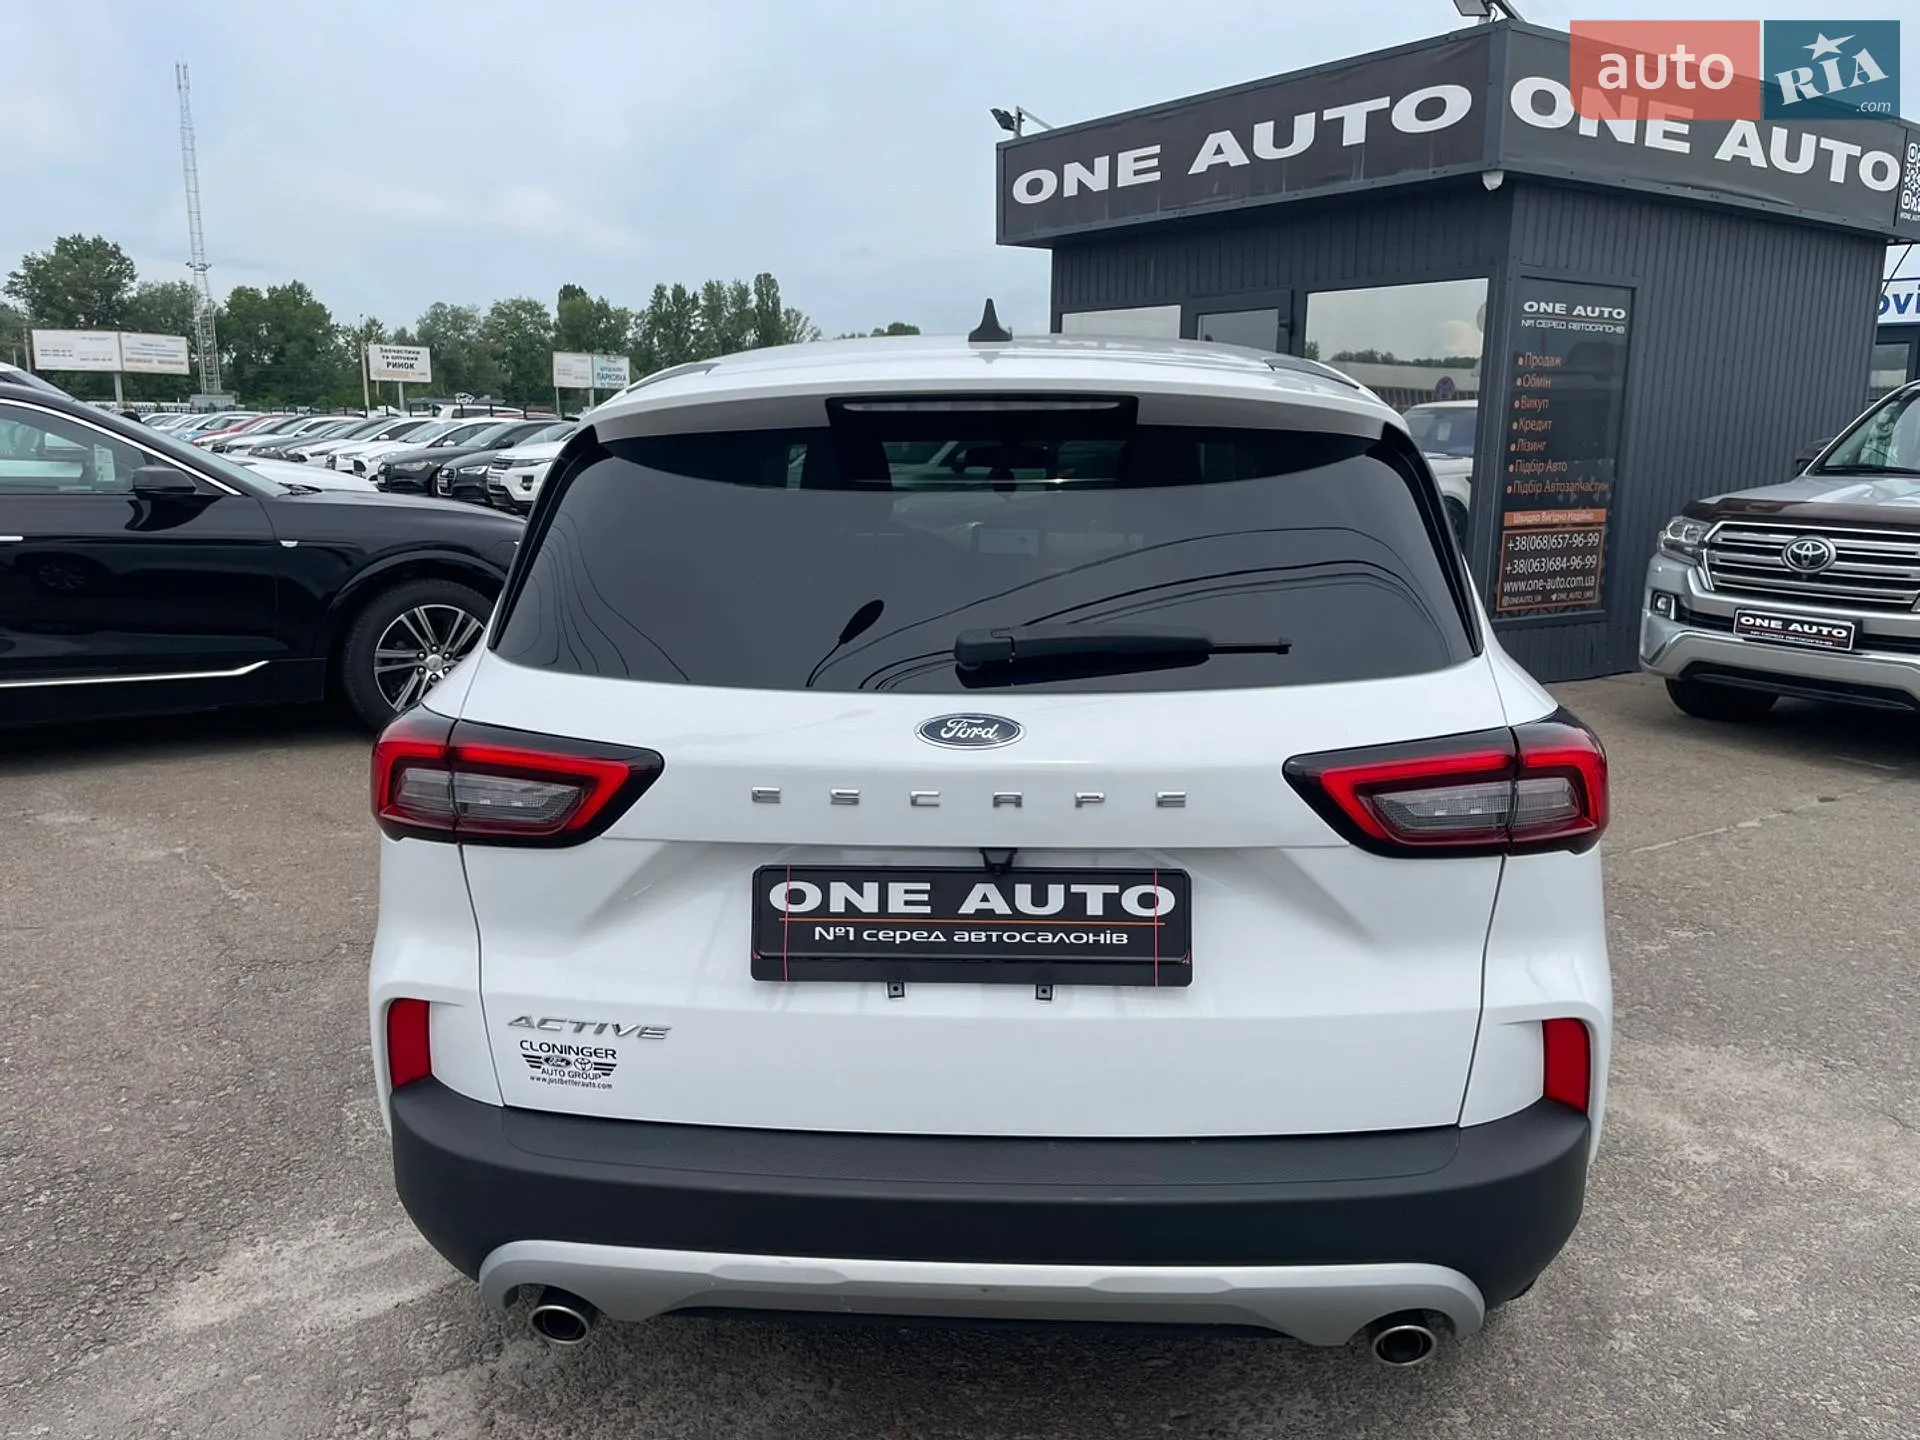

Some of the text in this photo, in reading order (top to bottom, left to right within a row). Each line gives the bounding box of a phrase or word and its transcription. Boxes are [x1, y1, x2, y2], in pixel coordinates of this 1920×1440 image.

[1510, 76, 1900, 192] ONE AUTO
[1011, 84, 1473, 204] ONE AUTO
[1523, 301, 1626, 319] ONE AUTO
[386, 361, 415, 369] РИНОК
[1525, 352, 1562, 368] Продаж
[1522, 374, 1551, 388] Обмін
[1521, 395, 1549, 412] Викуп
[1519, 417, 1552, 433] Кредит
[1516, 438, 1546, 452] Лізинг
[1514, 460, 1568, 475] Підбір Авто
[1512, 480, 1543, 496] Підбір
[1507, 532, 1600, 551] +38(068)657-96-99
[1505, 555, 1597, 575] +38(063)684-96-99
[1503, 576, 1595, 592] www.one-auto.com.ua
[1740, 616, 1847, 637] ONE AUTO
[940, 718, 998, 741] Ford
[751, 786, 1187, 807] ESCAPE
[769, 880, 1176, 918] ONE AUTO
[863, 929, 946, 944] серед
[953, 929, 1128, 945] автосалонів
[507, 1015, 672, 1040] ACTIVE
[519, 1040, 617, 1060] CLONINGER
[541, 1068, 602, 1080] AUTO GROUP
